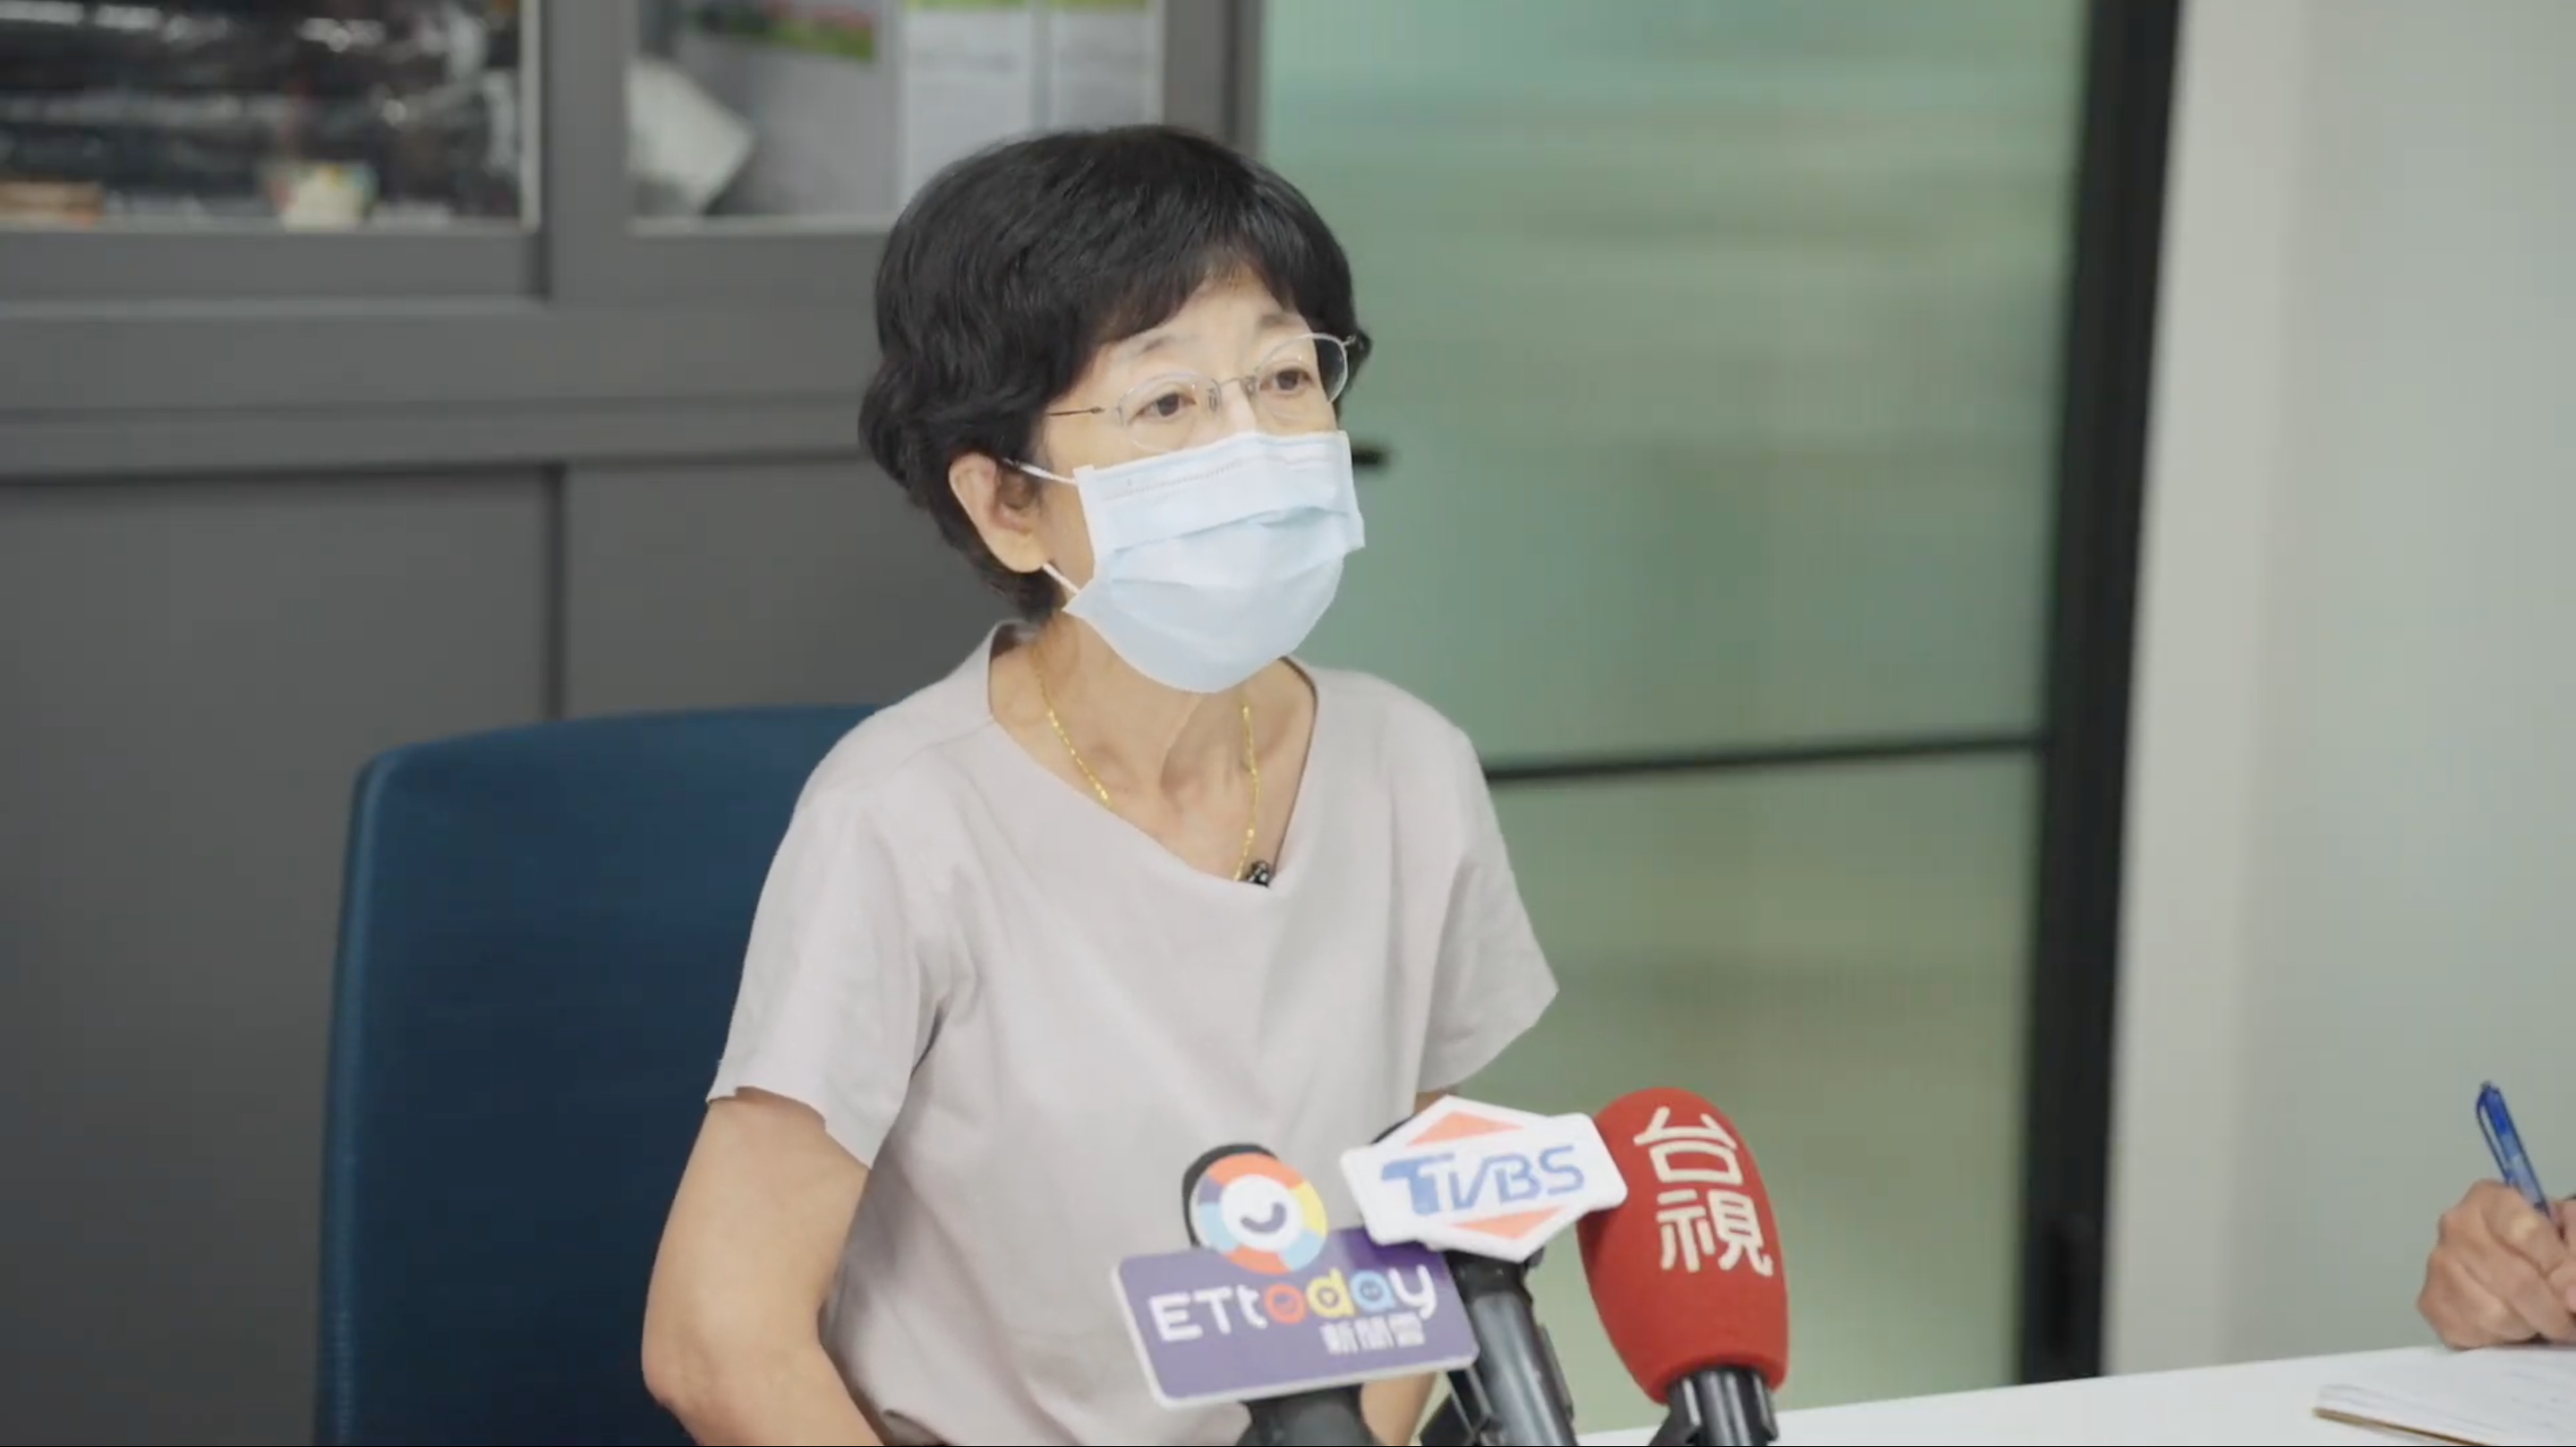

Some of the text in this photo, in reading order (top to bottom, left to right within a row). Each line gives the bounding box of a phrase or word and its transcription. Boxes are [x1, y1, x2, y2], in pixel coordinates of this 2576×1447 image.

[1381, 1145, 1585, 1215] TVBS
[1633, 1106, 1773, 1277] 台視
[1149, 1264, 1437, 1342] ETtoday
